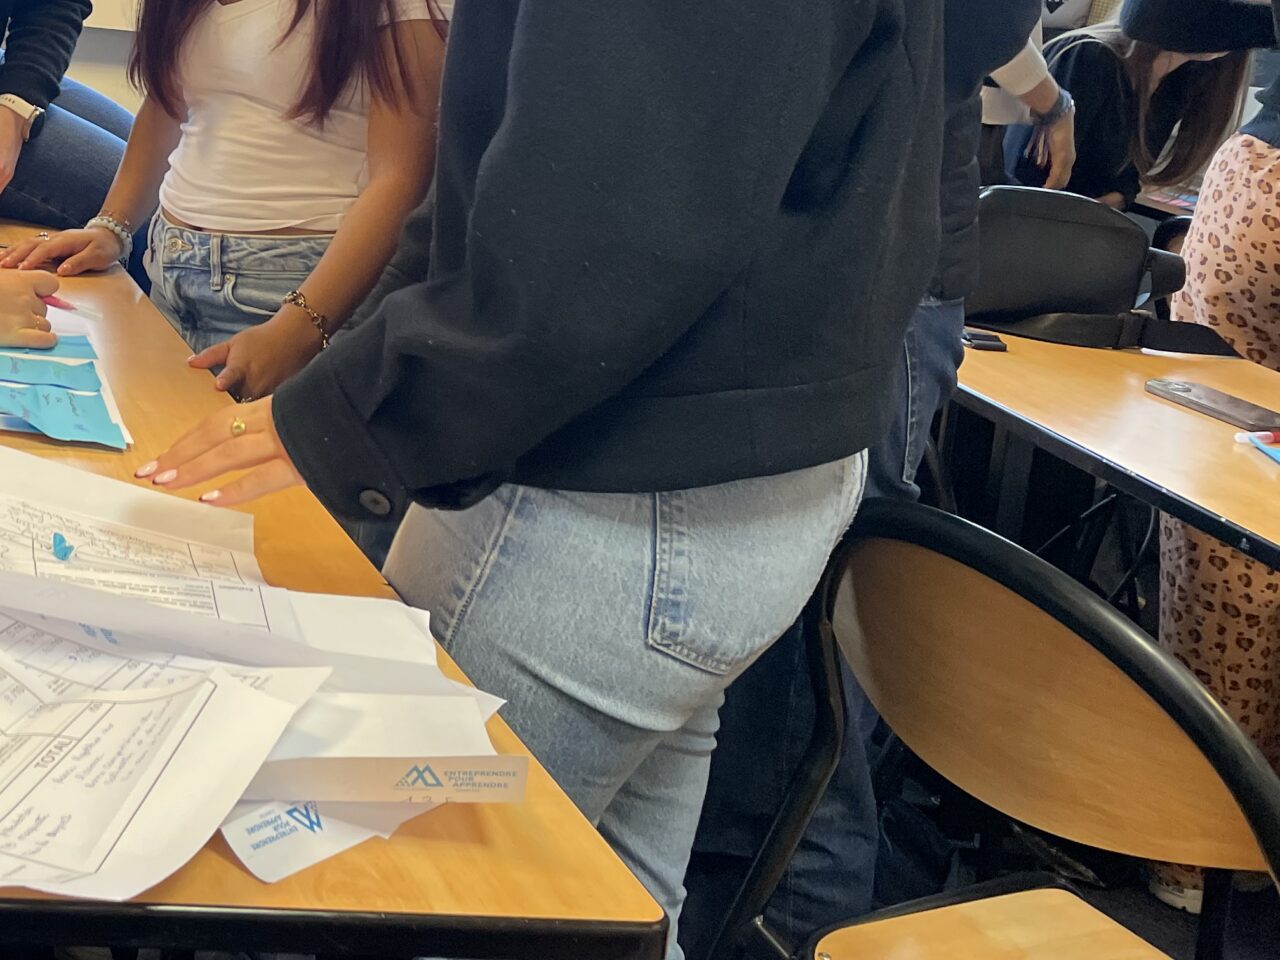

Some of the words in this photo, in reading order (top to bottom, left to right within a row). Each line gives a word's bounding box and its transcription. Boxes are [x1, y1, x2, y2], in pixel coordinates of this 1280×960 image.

[34, 737, 73, 770] TOTAL
[443, 770, 517, 778] ENTREPRENDRE
[452, 782, 509, 790] APPRENDRE
